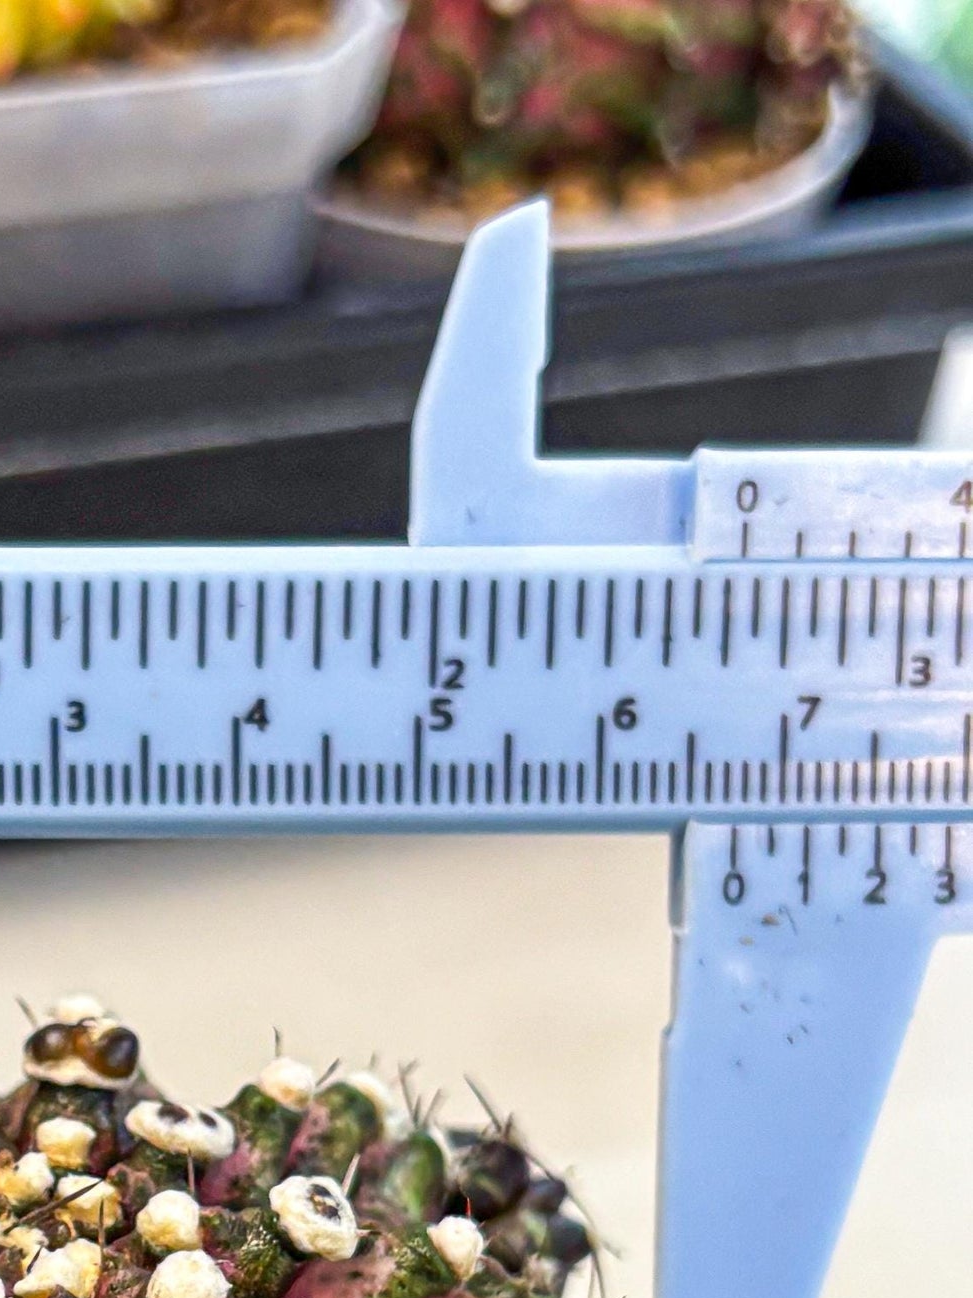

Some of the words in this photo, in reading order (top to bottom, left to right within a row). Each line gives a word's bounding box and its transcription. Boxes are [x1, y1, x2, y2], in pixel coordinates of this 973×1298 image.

[736, 479, 759, 513] 0
[949, 479, 973, 513] 4
[441, 658, 465, 690] 2
[908, 655, 932, 687] 3
[64, 699, 88, 733] 3
[242, 697, 270, 732] 4
[428, 697, 454, 732] 5
[612, 697, 638, 731] 6
[796, 696, 822, 731] 7
[722, 869, 746, 906] 0
[862, 867, 887, 905] 2
[933, 868, 957, 905] 3
